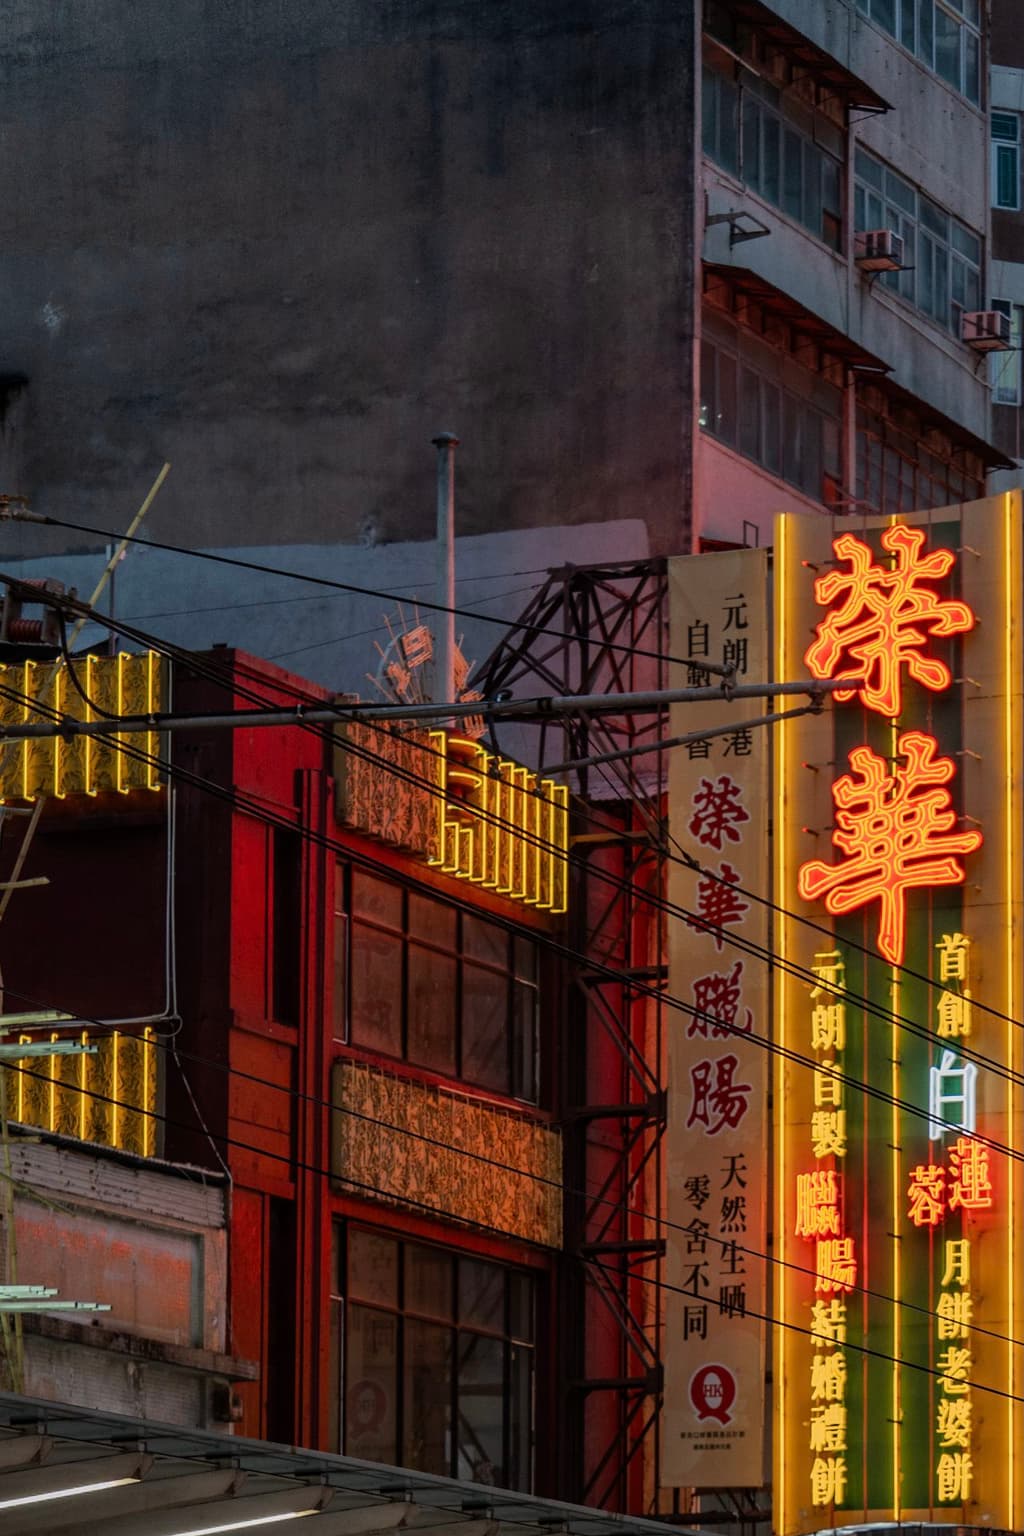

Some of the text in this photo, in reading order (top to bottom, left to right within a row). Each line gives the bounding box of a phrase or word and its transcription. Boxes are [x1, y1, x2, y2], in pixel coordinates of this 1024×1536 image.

[721, 593, 748, 675] 元朗
[798, 524, 983, 965] 榮華
[686, 776, 752, 1135] 榮華臘腸
[682, 1175, 710, 1341] 零舍不同
[719, 1152, 747, 1320] 天然生晒
